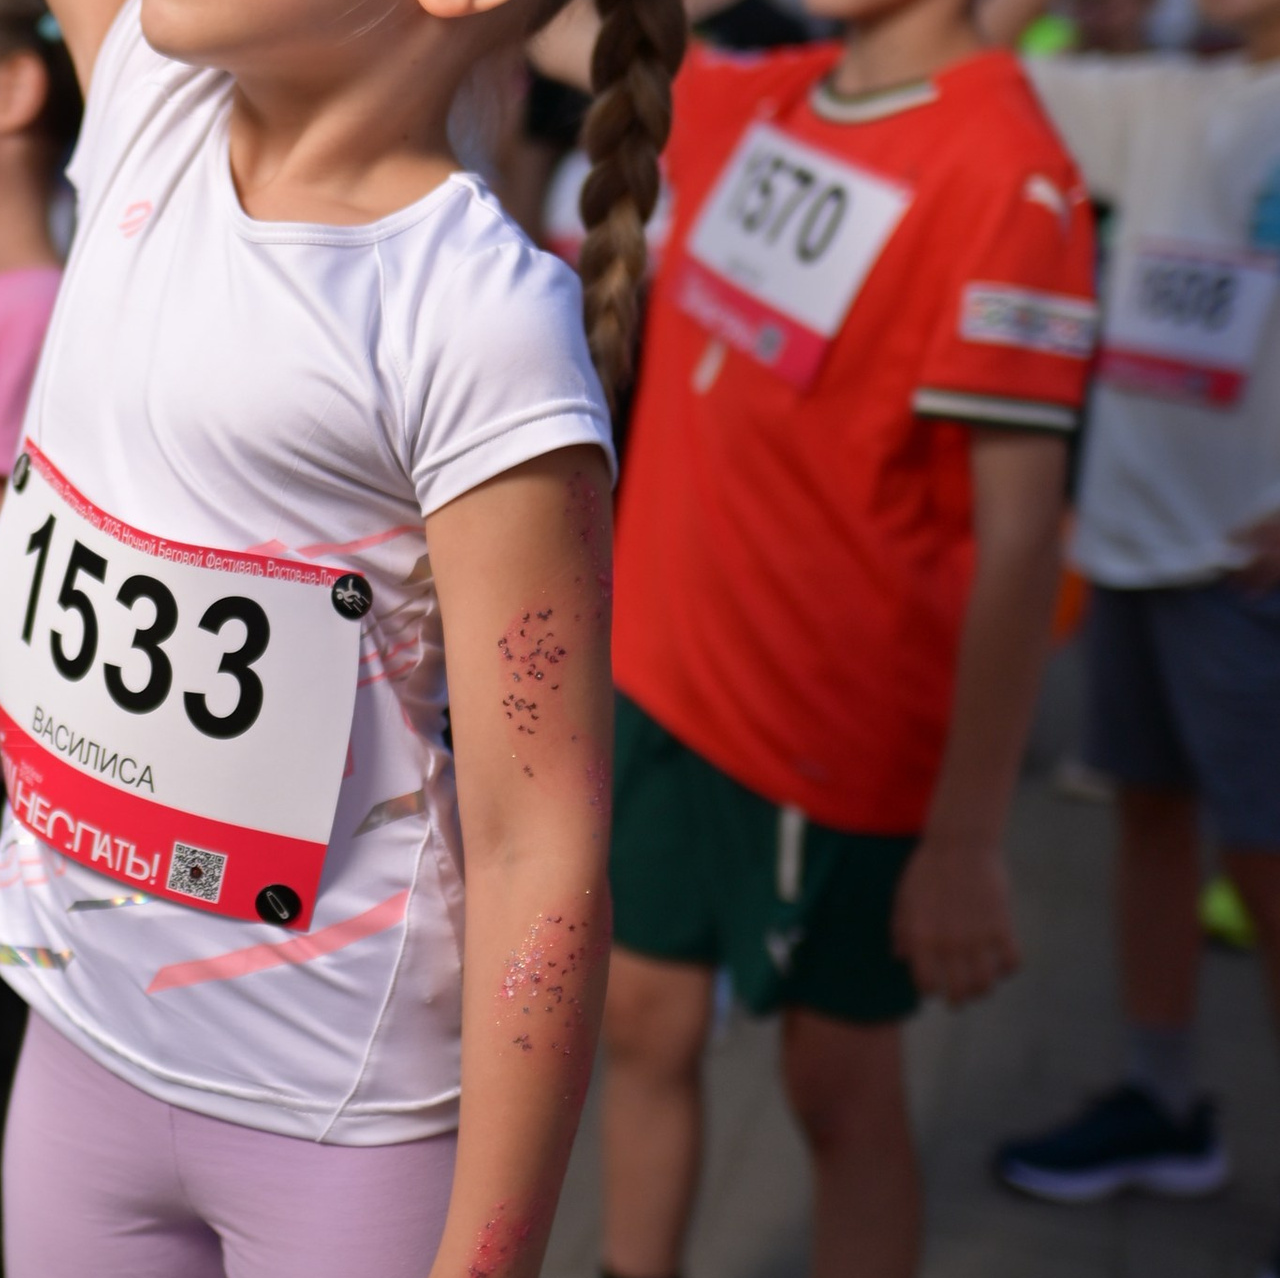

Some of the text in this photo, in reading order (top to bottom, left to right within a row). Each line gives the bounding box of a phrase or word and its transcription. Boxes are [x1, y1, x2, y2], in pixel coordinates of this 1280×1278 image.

[121, 526, 157, 556] Ночной
[158, 540, 204, 568] Беговой
[205, 550, 264, 576] Фестиваль
[267, 560, 339, 588] Ростов-на-Дон
[22, 513, 271, 740] 1533
[32, 706, 155, 793] ВАСИЛИСА
